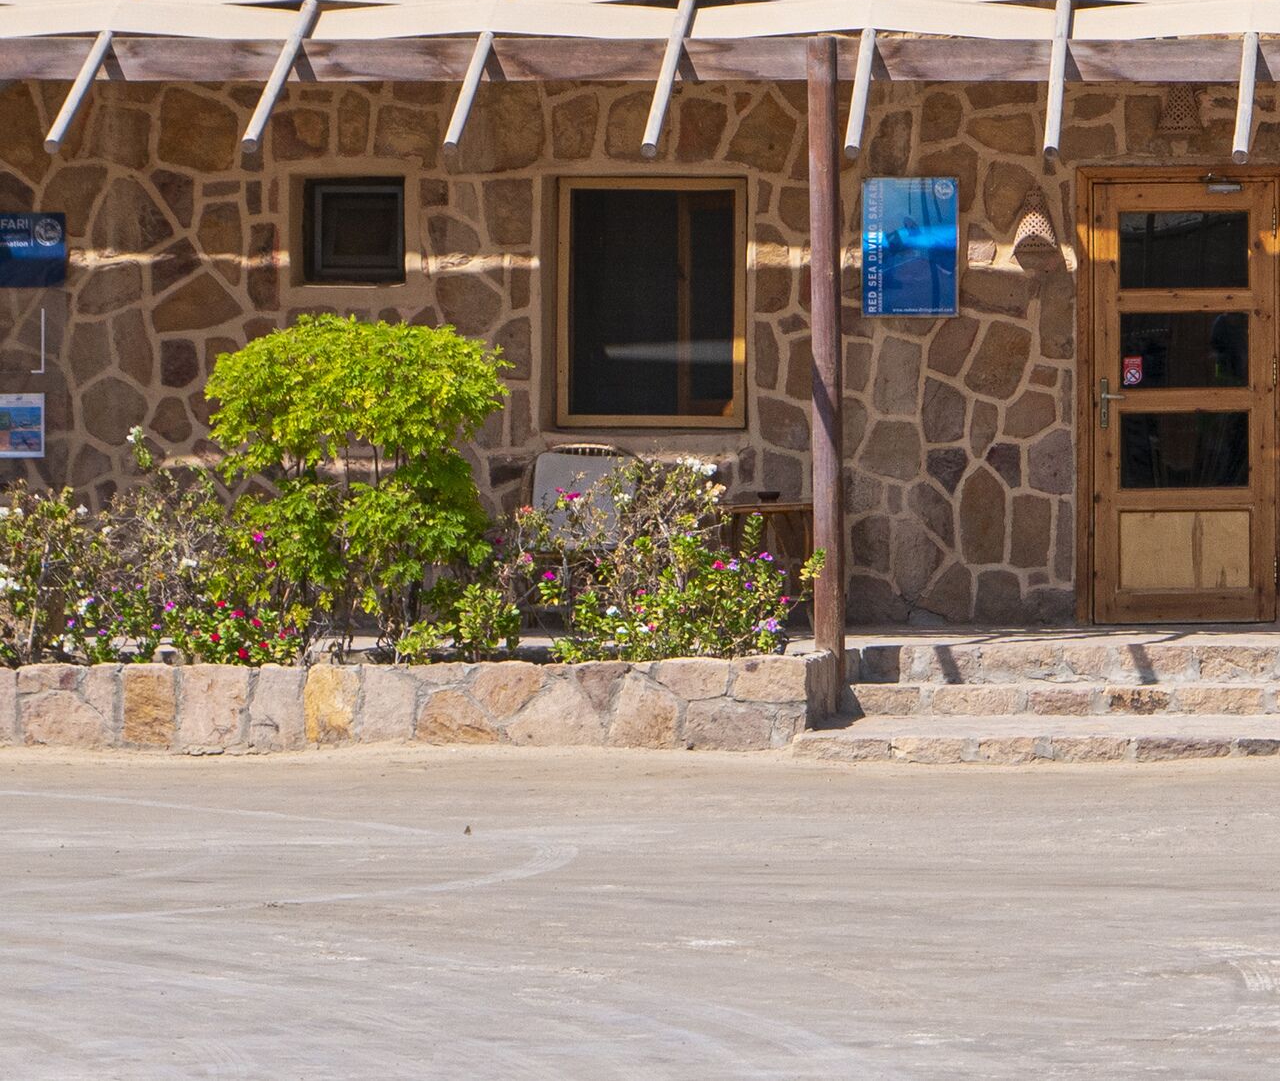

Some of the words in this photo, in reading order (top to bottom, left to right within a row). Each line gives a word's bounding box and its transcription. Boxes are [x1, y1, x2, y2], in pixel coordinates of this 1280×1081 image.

[868, 224, 877, 261] DIVING
[868, 266, 877, 287] SEA
[868, 291, 877, 313] RED
